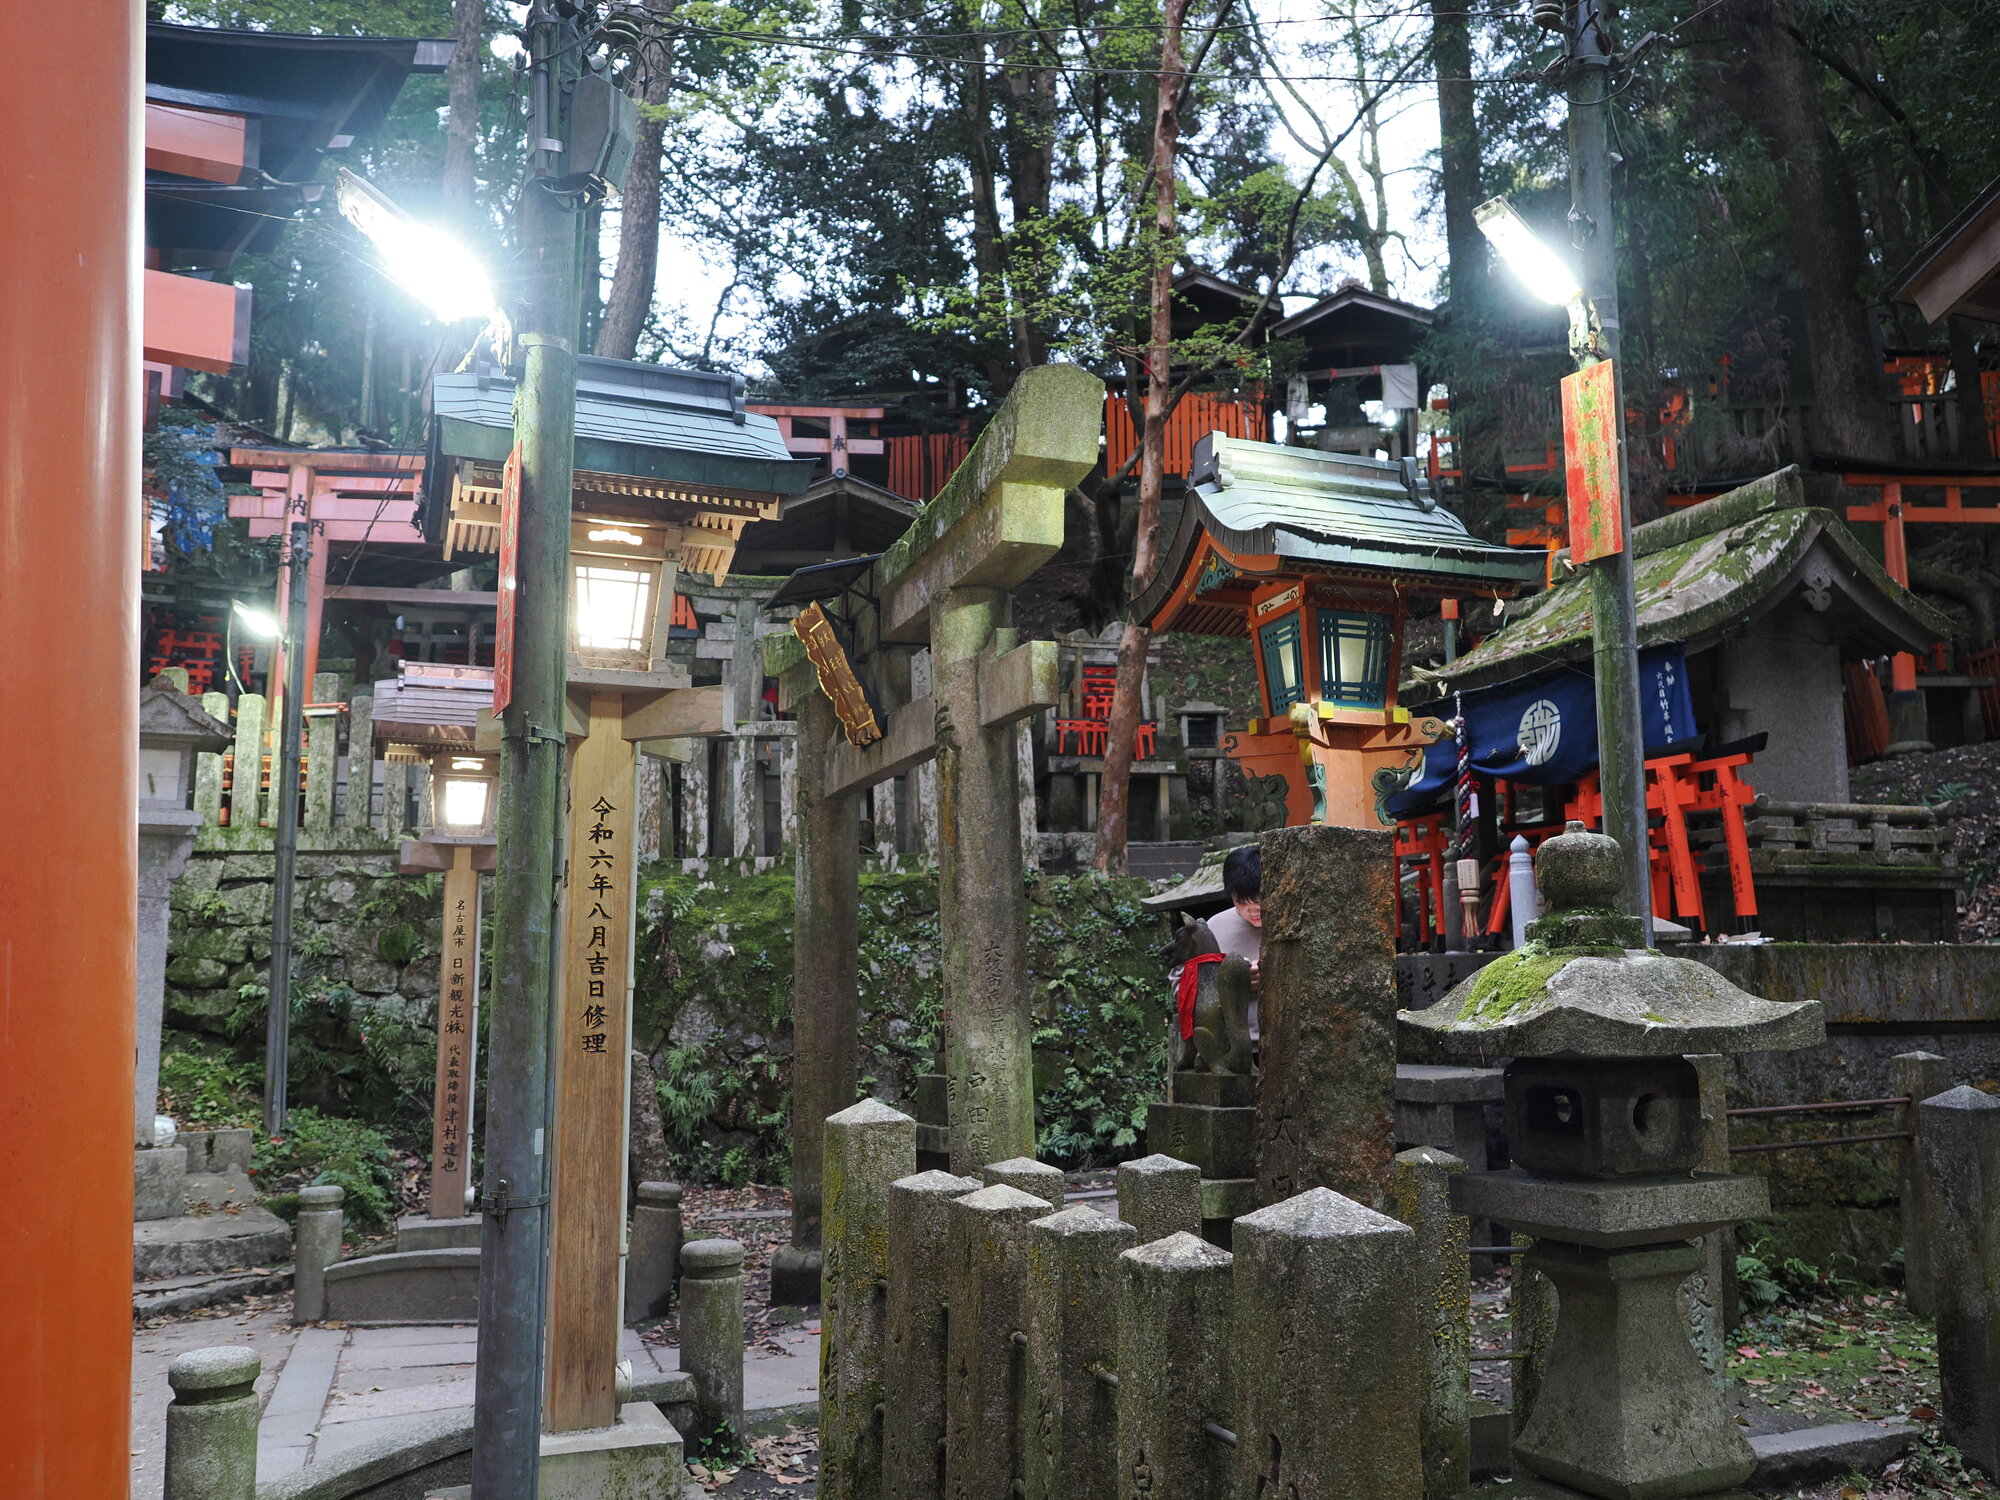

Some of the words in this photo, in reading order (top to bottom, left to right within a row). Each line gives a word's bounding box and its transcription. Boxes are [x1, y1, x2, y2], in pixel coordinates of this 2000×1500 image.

[832, 434, 847, 453] 奉
[452, 900, 466, 949] 名古屋市
[581, 796, 617, 1054] 令和六年八月吉日修理
